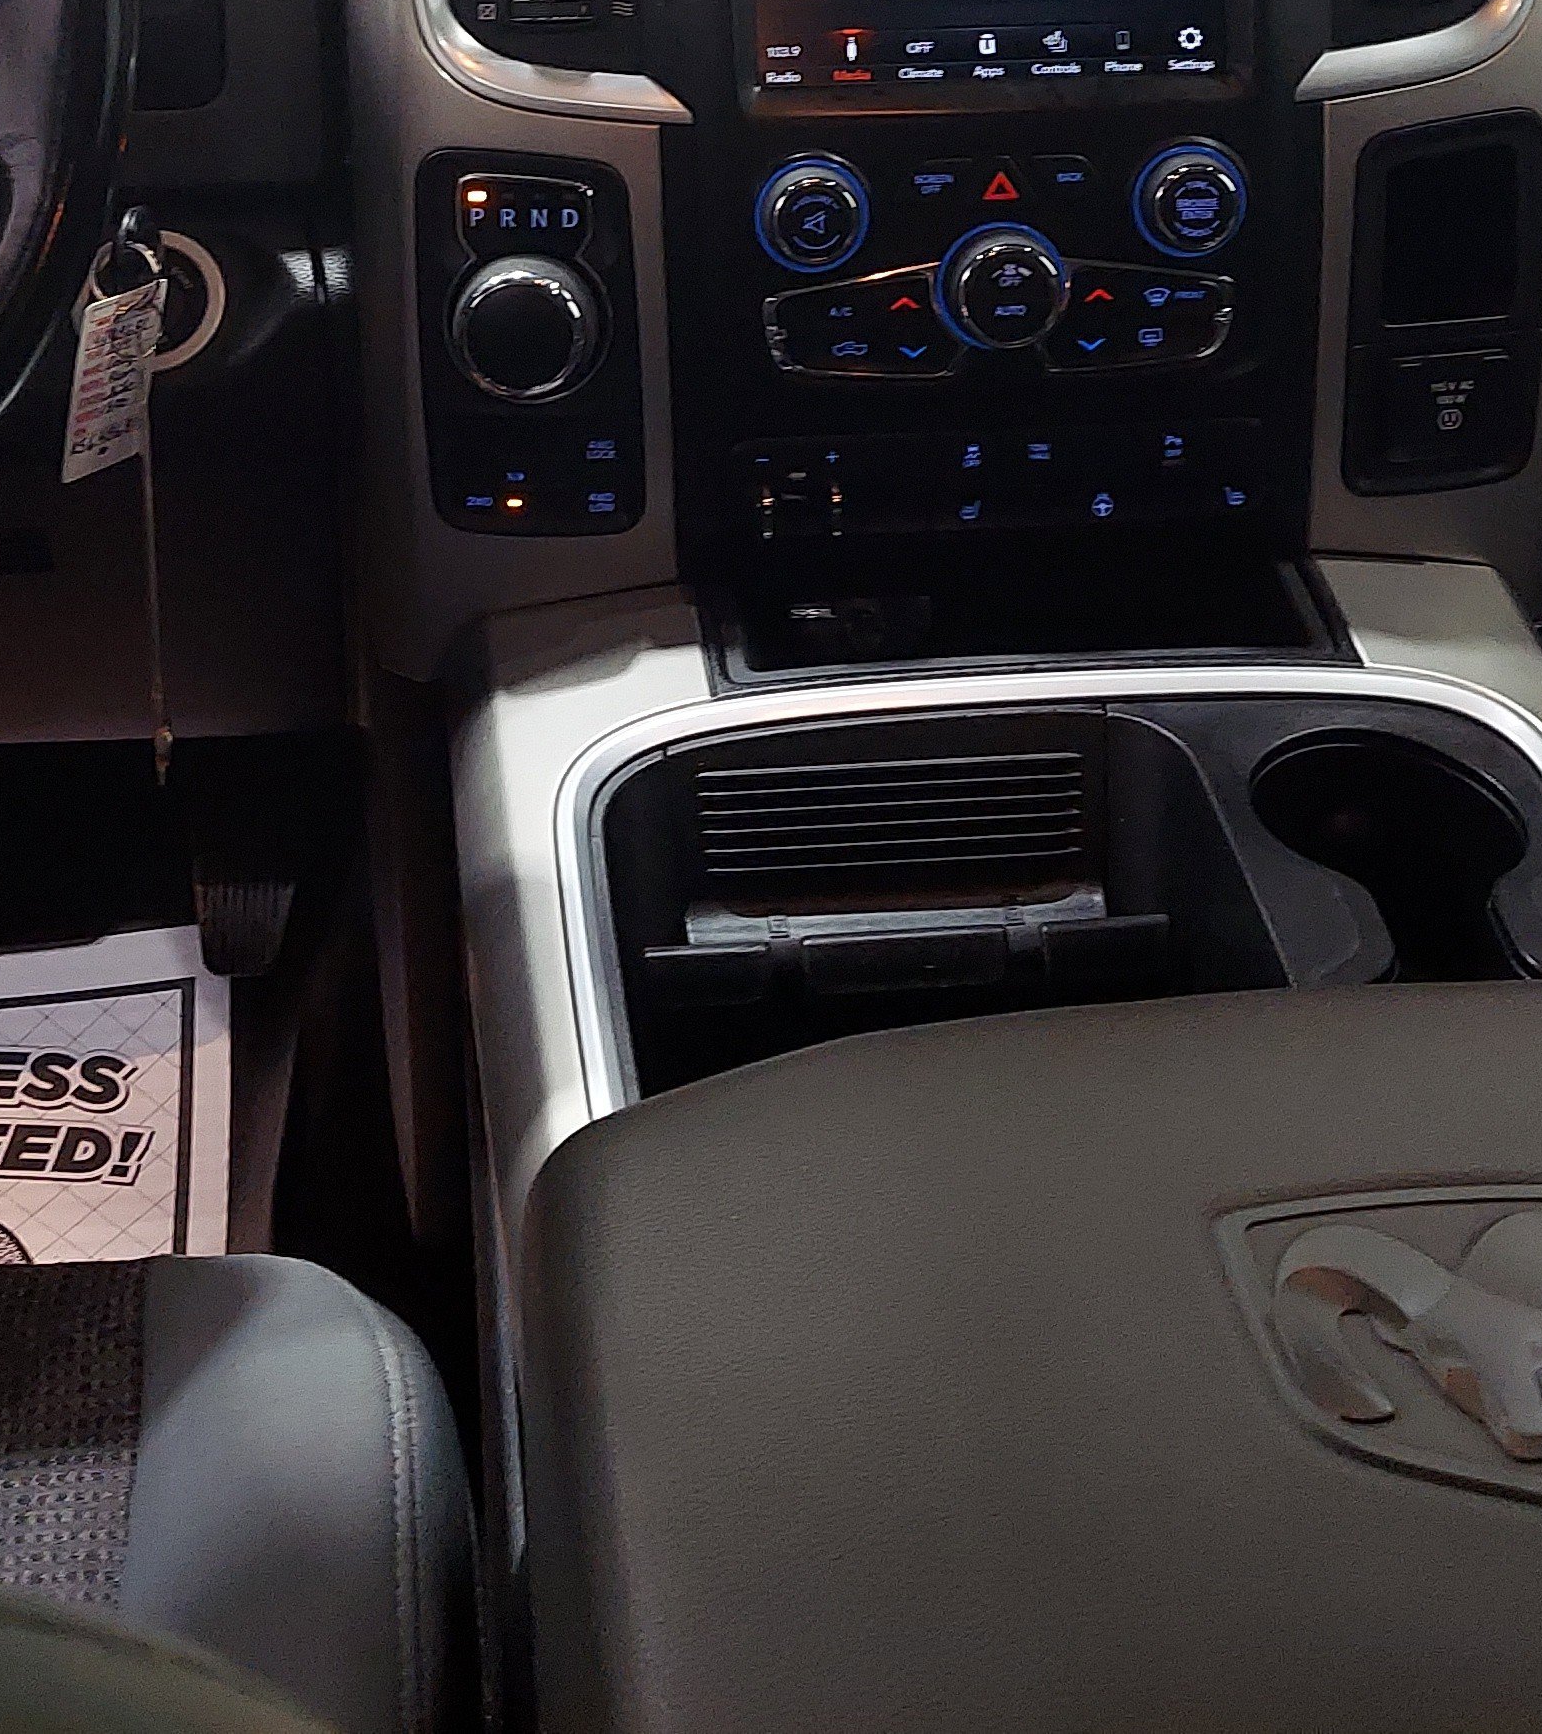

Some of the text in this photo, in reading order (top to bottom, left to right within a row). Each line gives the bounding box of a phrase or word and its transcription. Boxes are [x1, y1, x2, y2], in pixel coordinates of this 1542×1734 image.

[469, 207, 579, 228] P R N D
